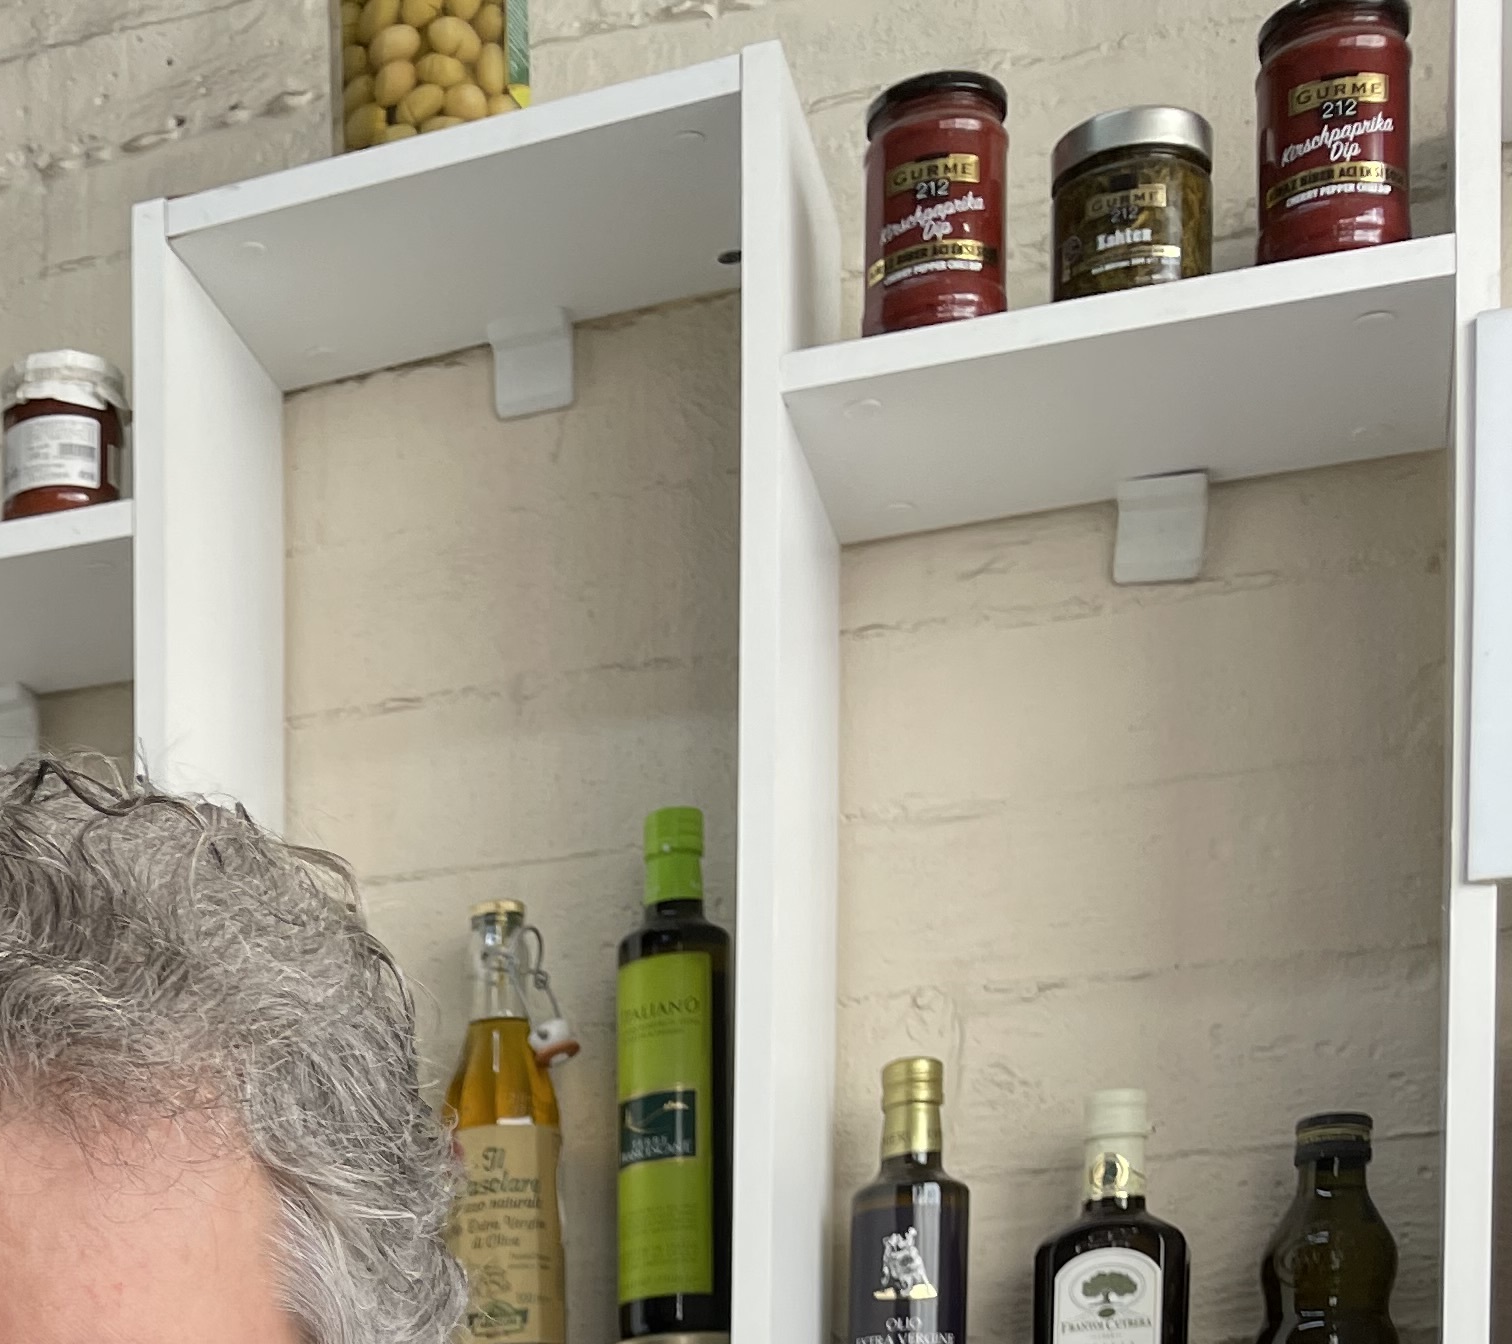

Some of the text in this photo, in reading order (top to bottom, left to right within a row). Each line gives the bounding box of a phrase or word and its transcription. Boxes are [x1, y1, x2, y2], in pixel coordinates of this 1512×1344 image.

[1296, 82, 1383, 105] GURME
[1322, 98, 1358, 119] 212
[1330, 140, 1362, 162] Dip
[893, 163, 974, 187] GURME
[916, 178, 950, 200] 212
[1111, 206, 1138, 223] 212
[885, 1316, 922, 1332] OLIO
